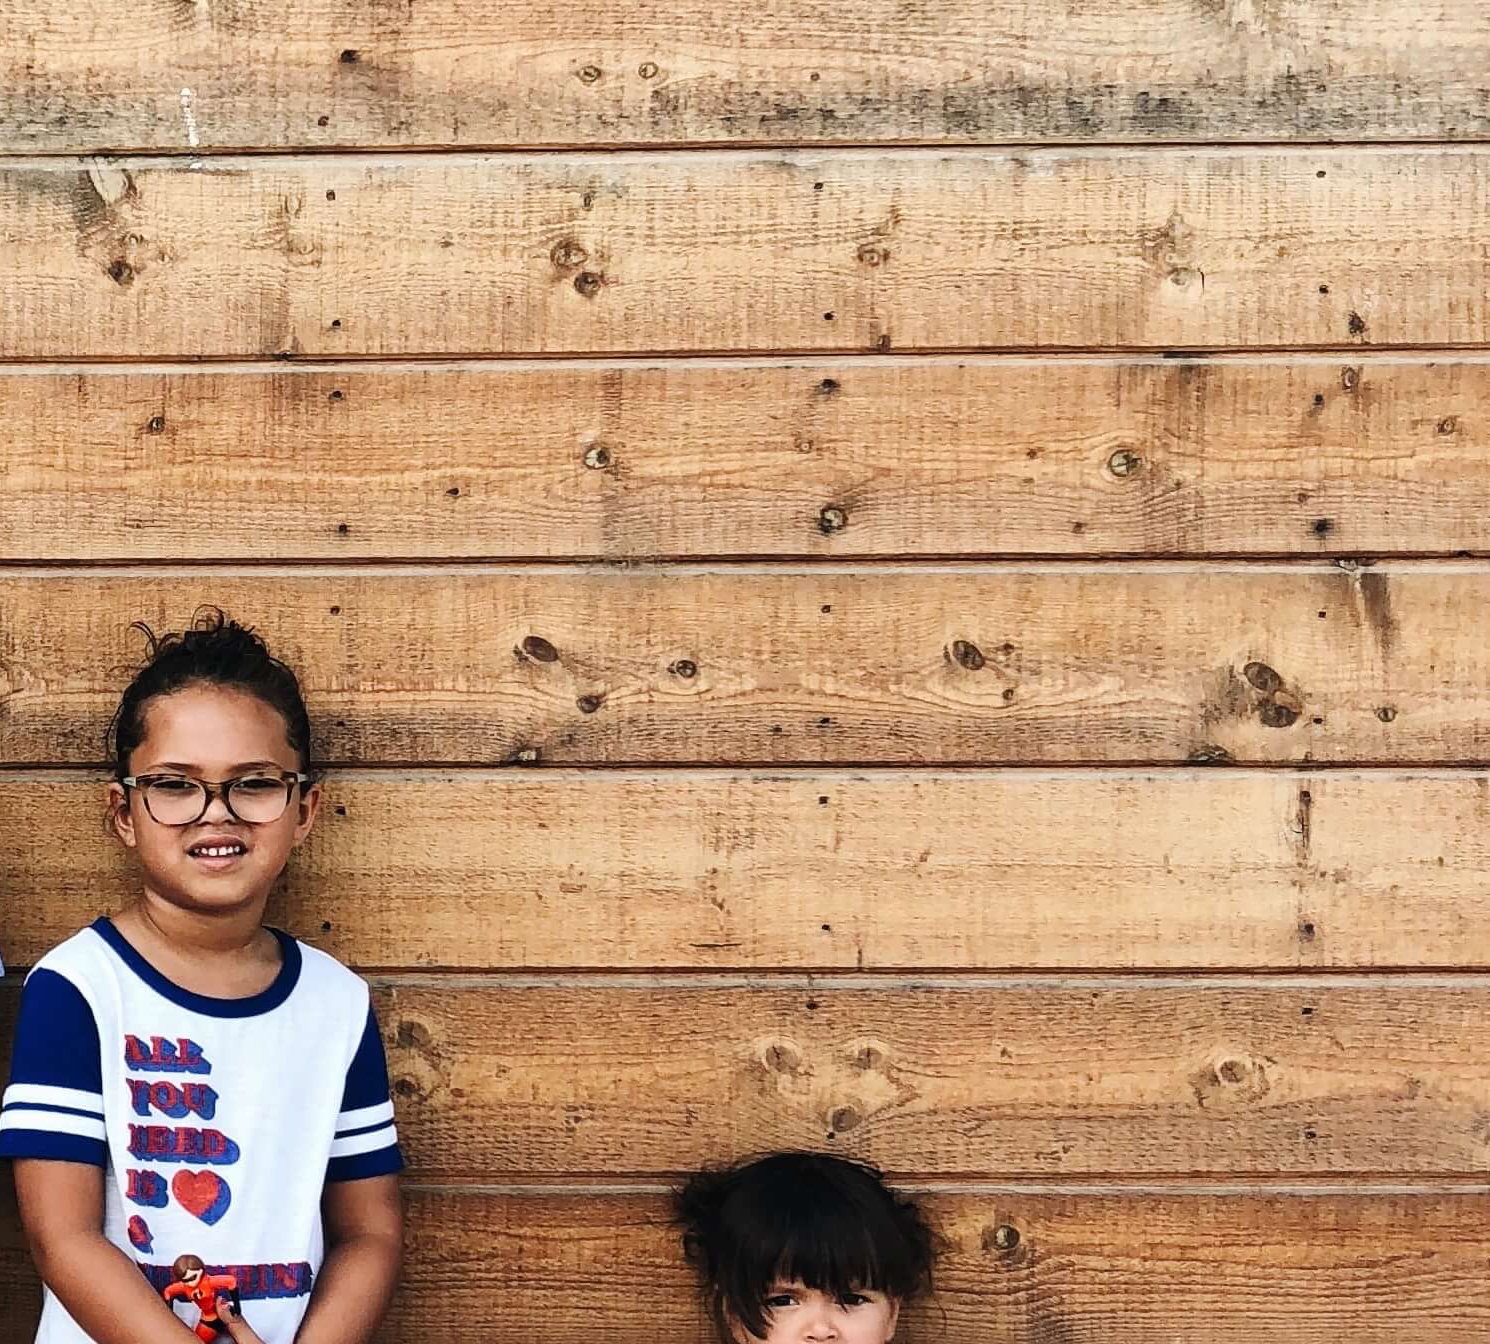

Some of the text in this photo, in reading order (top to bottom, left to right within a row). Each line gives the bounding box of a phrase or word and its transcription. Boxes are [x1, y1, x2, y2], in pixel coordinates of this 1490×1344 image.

[124, 1034, 212, 1075] ALL
[125, 1077, 220, 1121] YOU
[126, 1123, 240, 1166] NEED
[125, 1168, 170, 1209] IS
